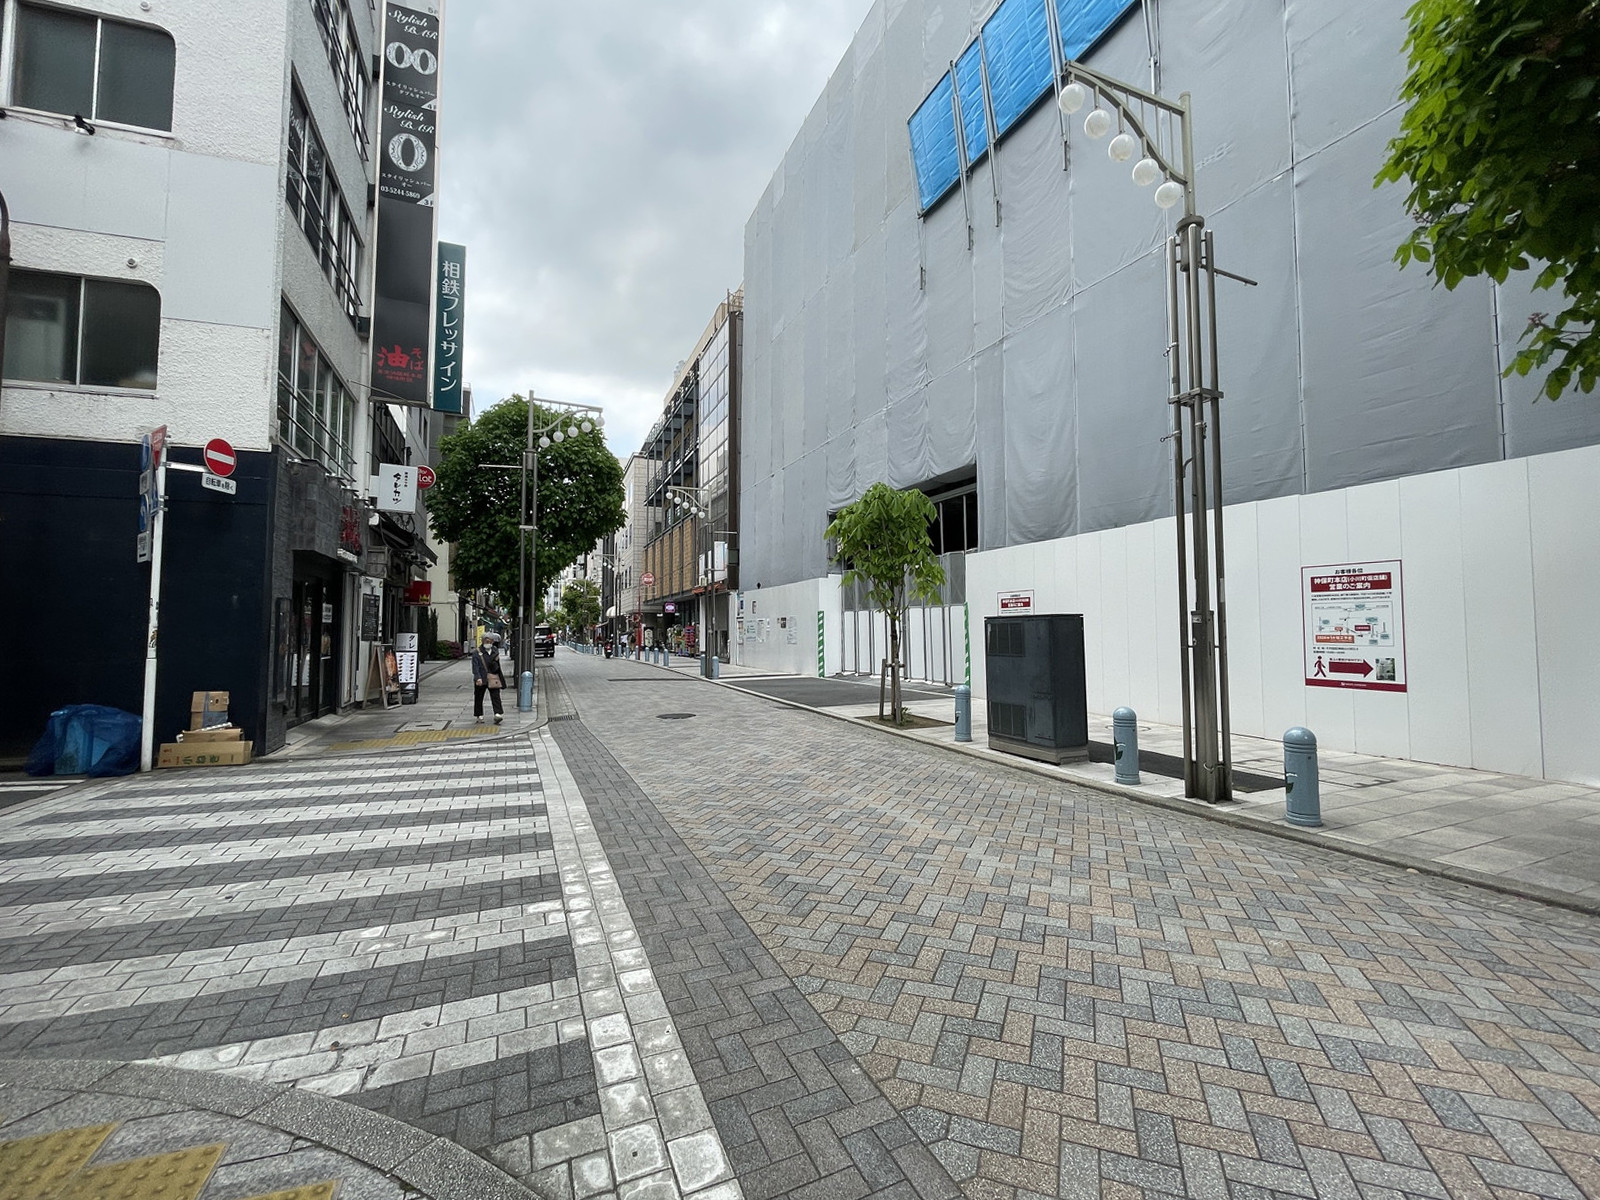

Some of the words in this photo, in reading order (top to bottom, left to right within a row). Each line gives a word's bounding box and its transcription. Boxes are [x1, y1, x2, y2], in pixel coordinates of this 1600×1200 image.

[388, 10, 428, 27] Stylish
[384, 105, 424, 122] Stylish
[440, 260, 460, 392] 相鉄フレッサイン
[1329, 582, 1371, 591] 営業のご案内
